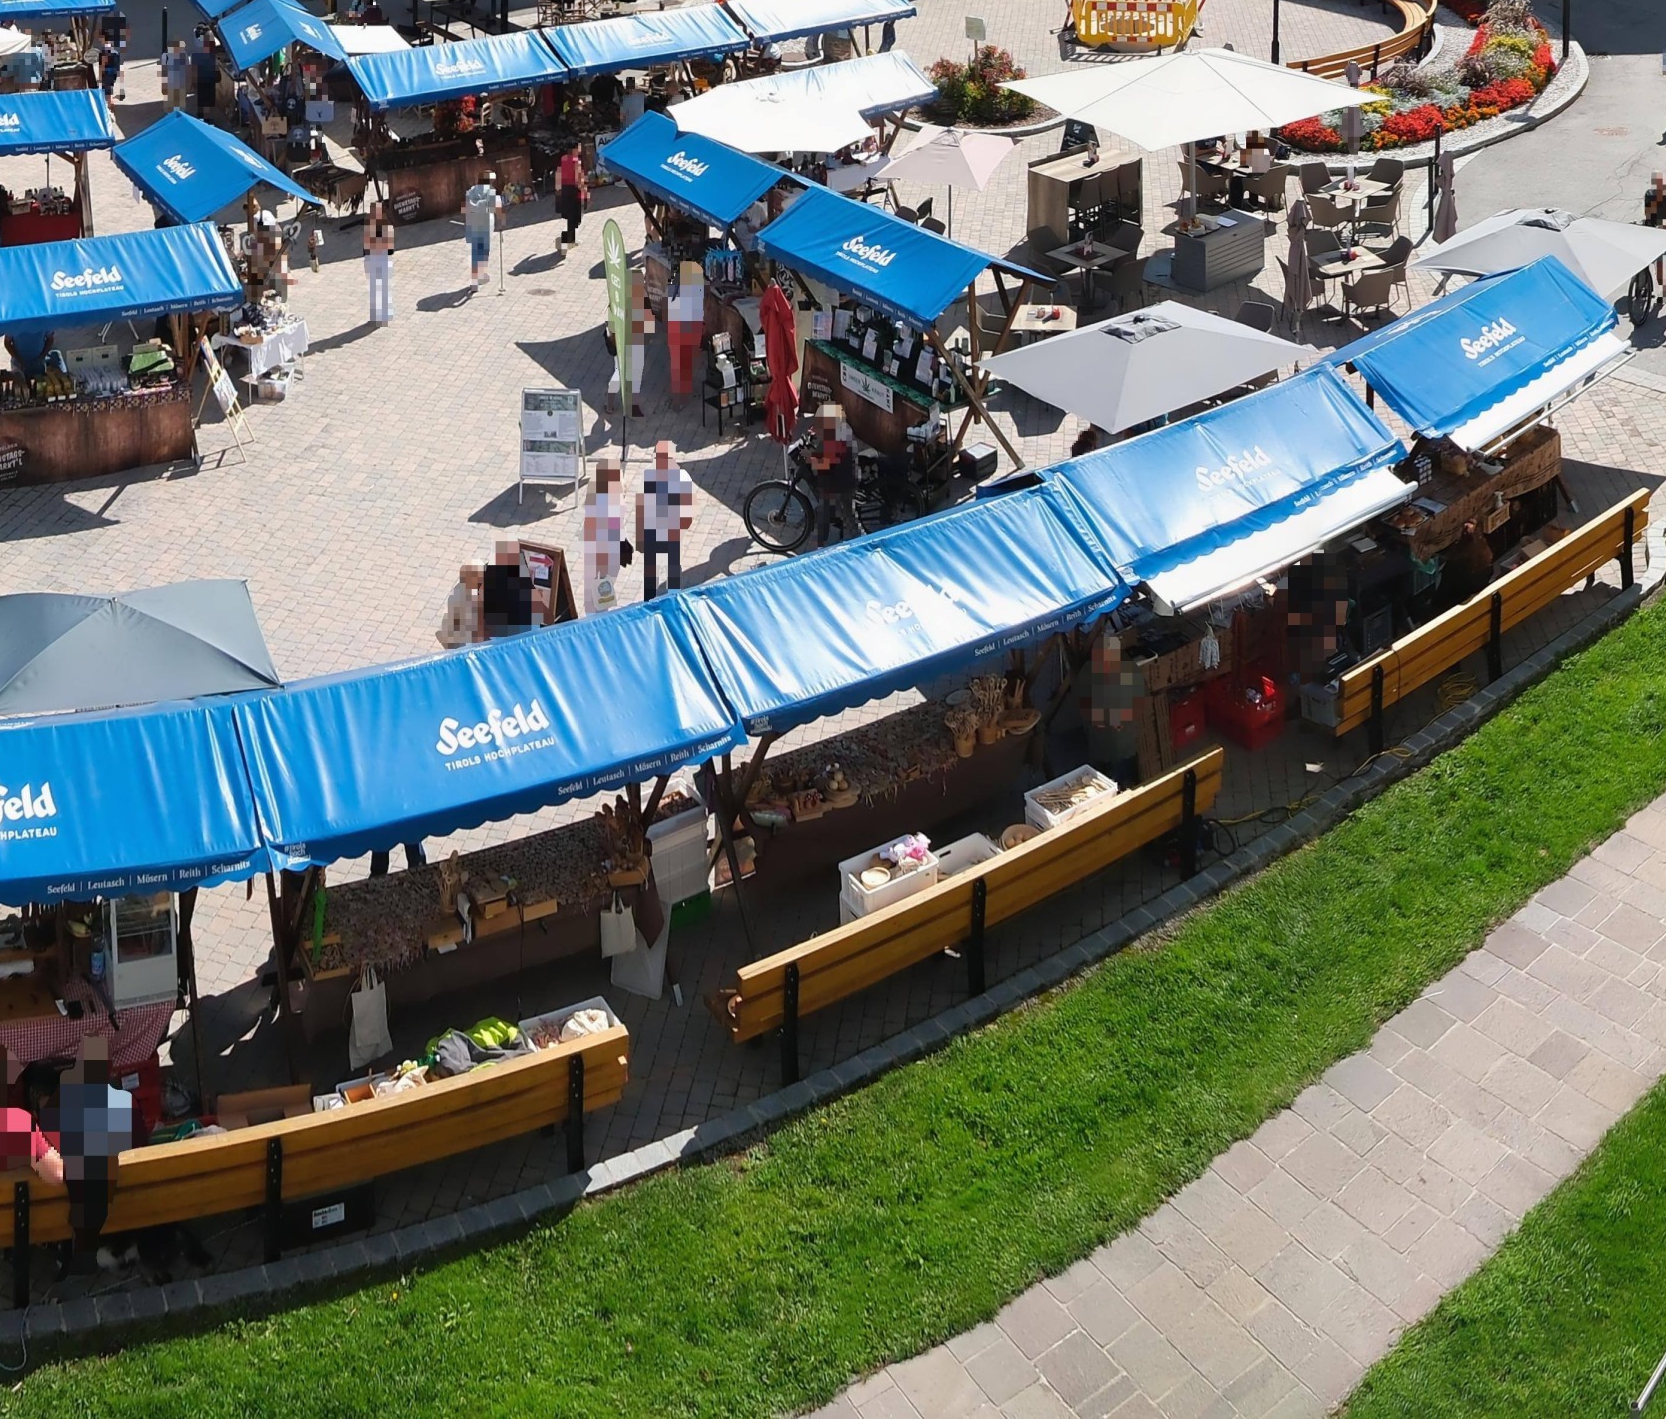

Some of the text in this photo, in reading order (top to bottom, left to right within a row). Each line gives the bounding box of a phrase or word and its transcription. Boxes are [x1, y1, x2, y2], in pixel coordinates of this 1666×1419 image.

[667, 150, 710, 178] Seefeld
[843, 236, 898, 267] Seefeld
[50, 265, 123, 292] Seefeld
[1459, 316, 1518, 361] Seefeld
[974, 595, 1118, 658] Seefeld Leutasch Mösern Reith Scharnitz
[435, 698, 551, 754] Seefeld
[444, 736, 556, 772] TIROLS HOCHPLATEAU
[557, 734, 733, 797] Seefeld Leutasch Mösern Reith Scharnitz
[46, 859, 251, 895] Seefeld Leutasch Mösern Reith Scharnitz
